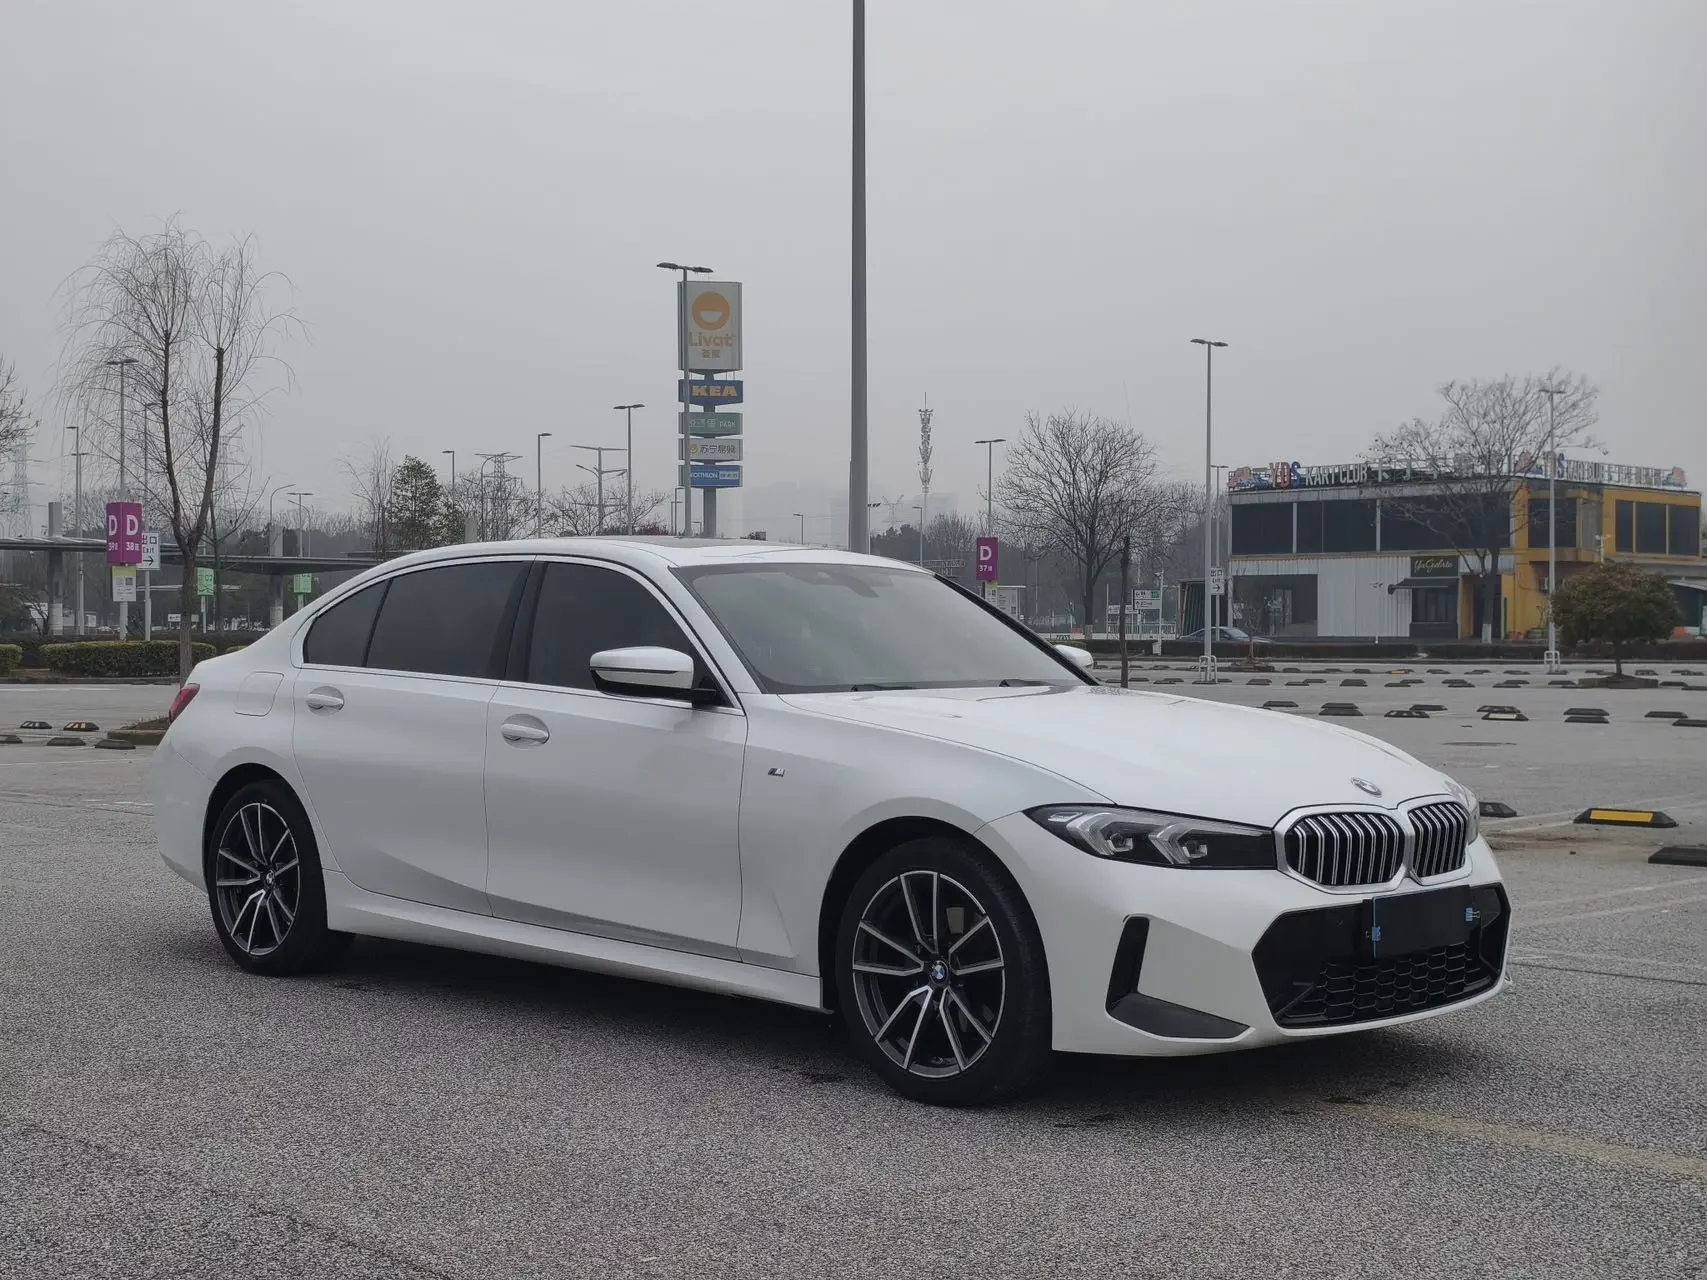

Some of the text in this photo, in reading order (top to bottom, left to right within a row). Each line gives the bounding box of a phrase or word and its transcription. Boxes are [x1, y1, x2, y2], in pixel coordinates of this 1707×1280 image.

[688, 331, 733, 348] Livat
[691, 385, 738, 397] KEA
[1305, 464, 1337, 486] KART
[1339, 462, 1369, 484] CLUB
[108, 515, 118, 536] D
[126, 514, 139, 536] D
[979, 545, 992, 561] D
